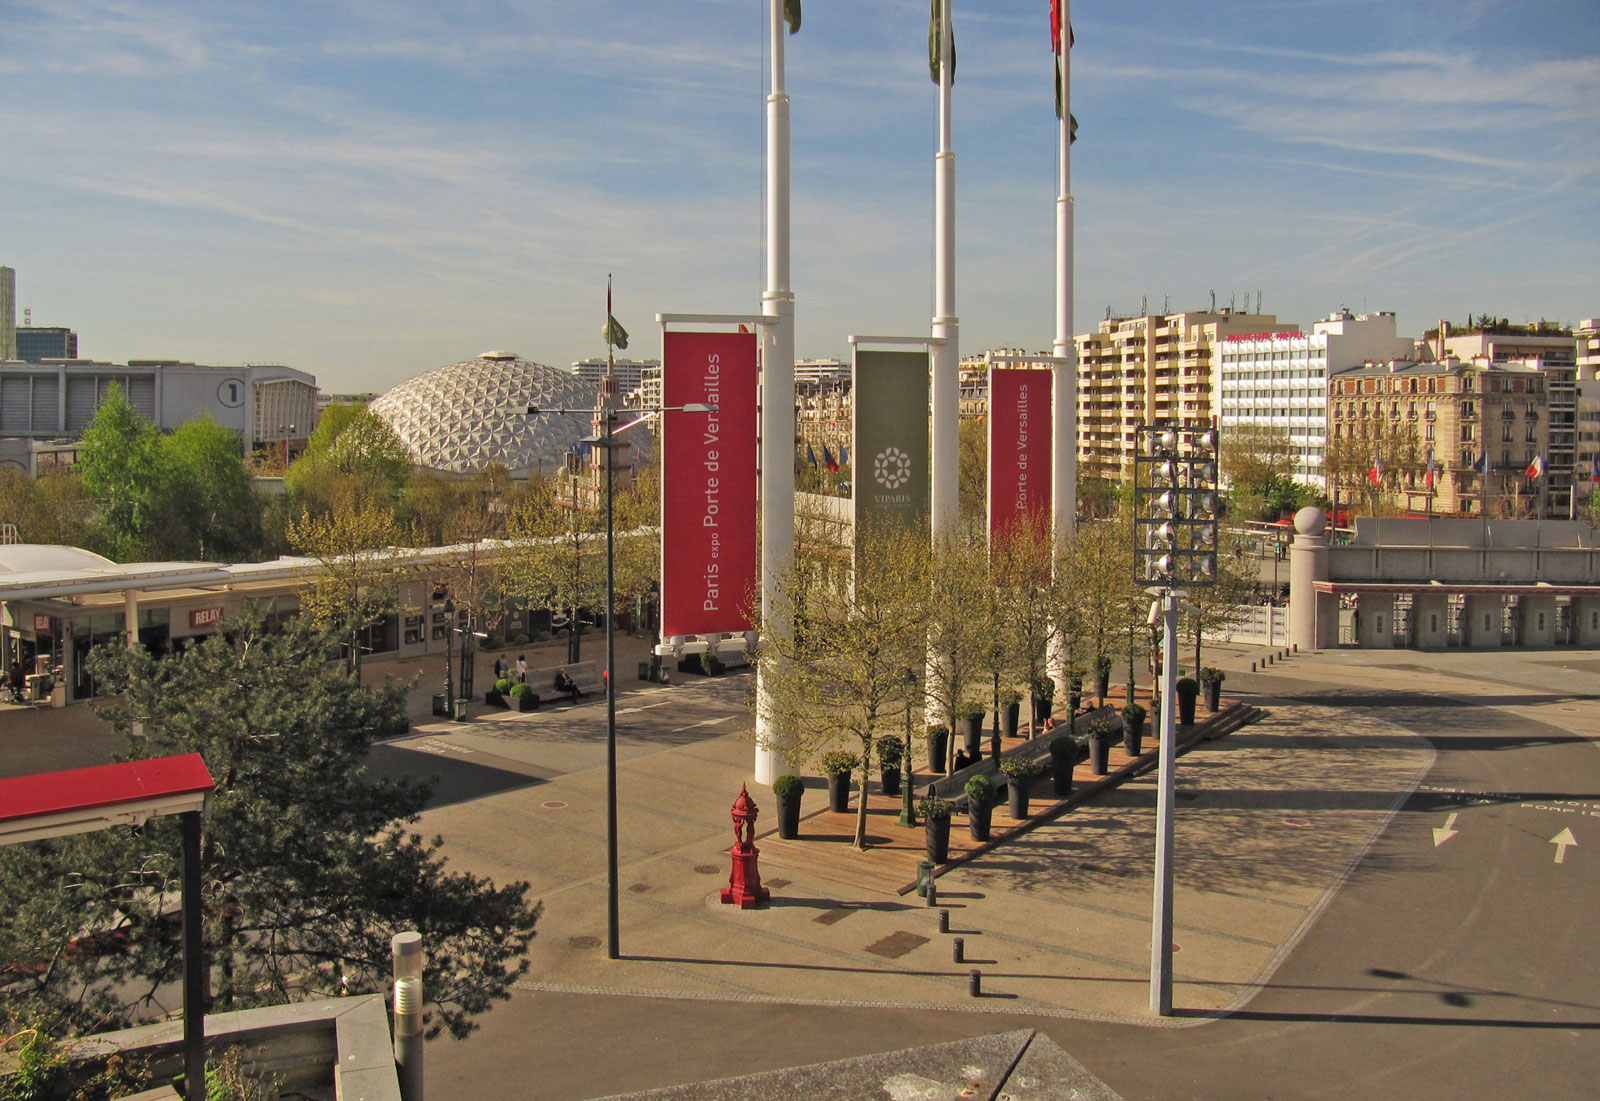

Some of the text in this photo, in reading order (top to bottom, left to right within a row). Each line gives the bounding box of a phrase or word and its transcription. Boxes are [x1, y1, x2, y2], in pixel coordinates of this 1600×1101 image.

[229, 384, 237, 402] 1
[1016, 384, 1028, 510] Porte de Versailles
[703, 450, 720, 472] de
[703, 477, 719, 527] Porte
[874, 495, 910, 503] VIPARIS
[711, 532, 721, 558] expo
[703, 563, 719, 611] Paris
[195, 607, 221, 625] RELAY
